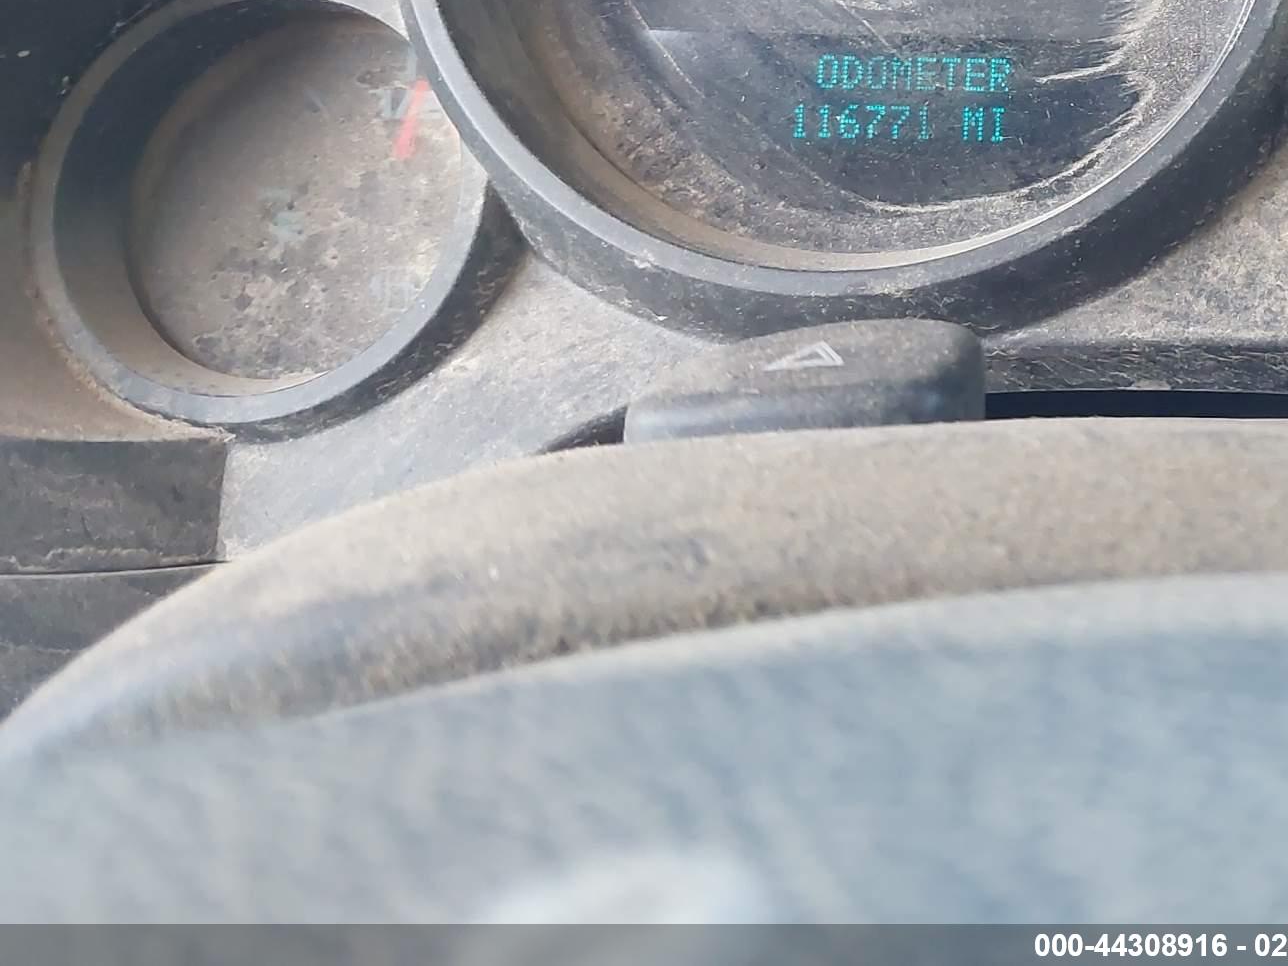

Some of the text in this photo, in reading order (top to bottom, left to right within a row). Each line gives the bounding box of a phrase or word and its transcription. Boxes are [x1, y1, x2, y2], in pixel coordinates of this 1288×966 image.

[816, 54, 1012, 92] ODOMETER
[793, 103, 1006, 142] 116771 MI
